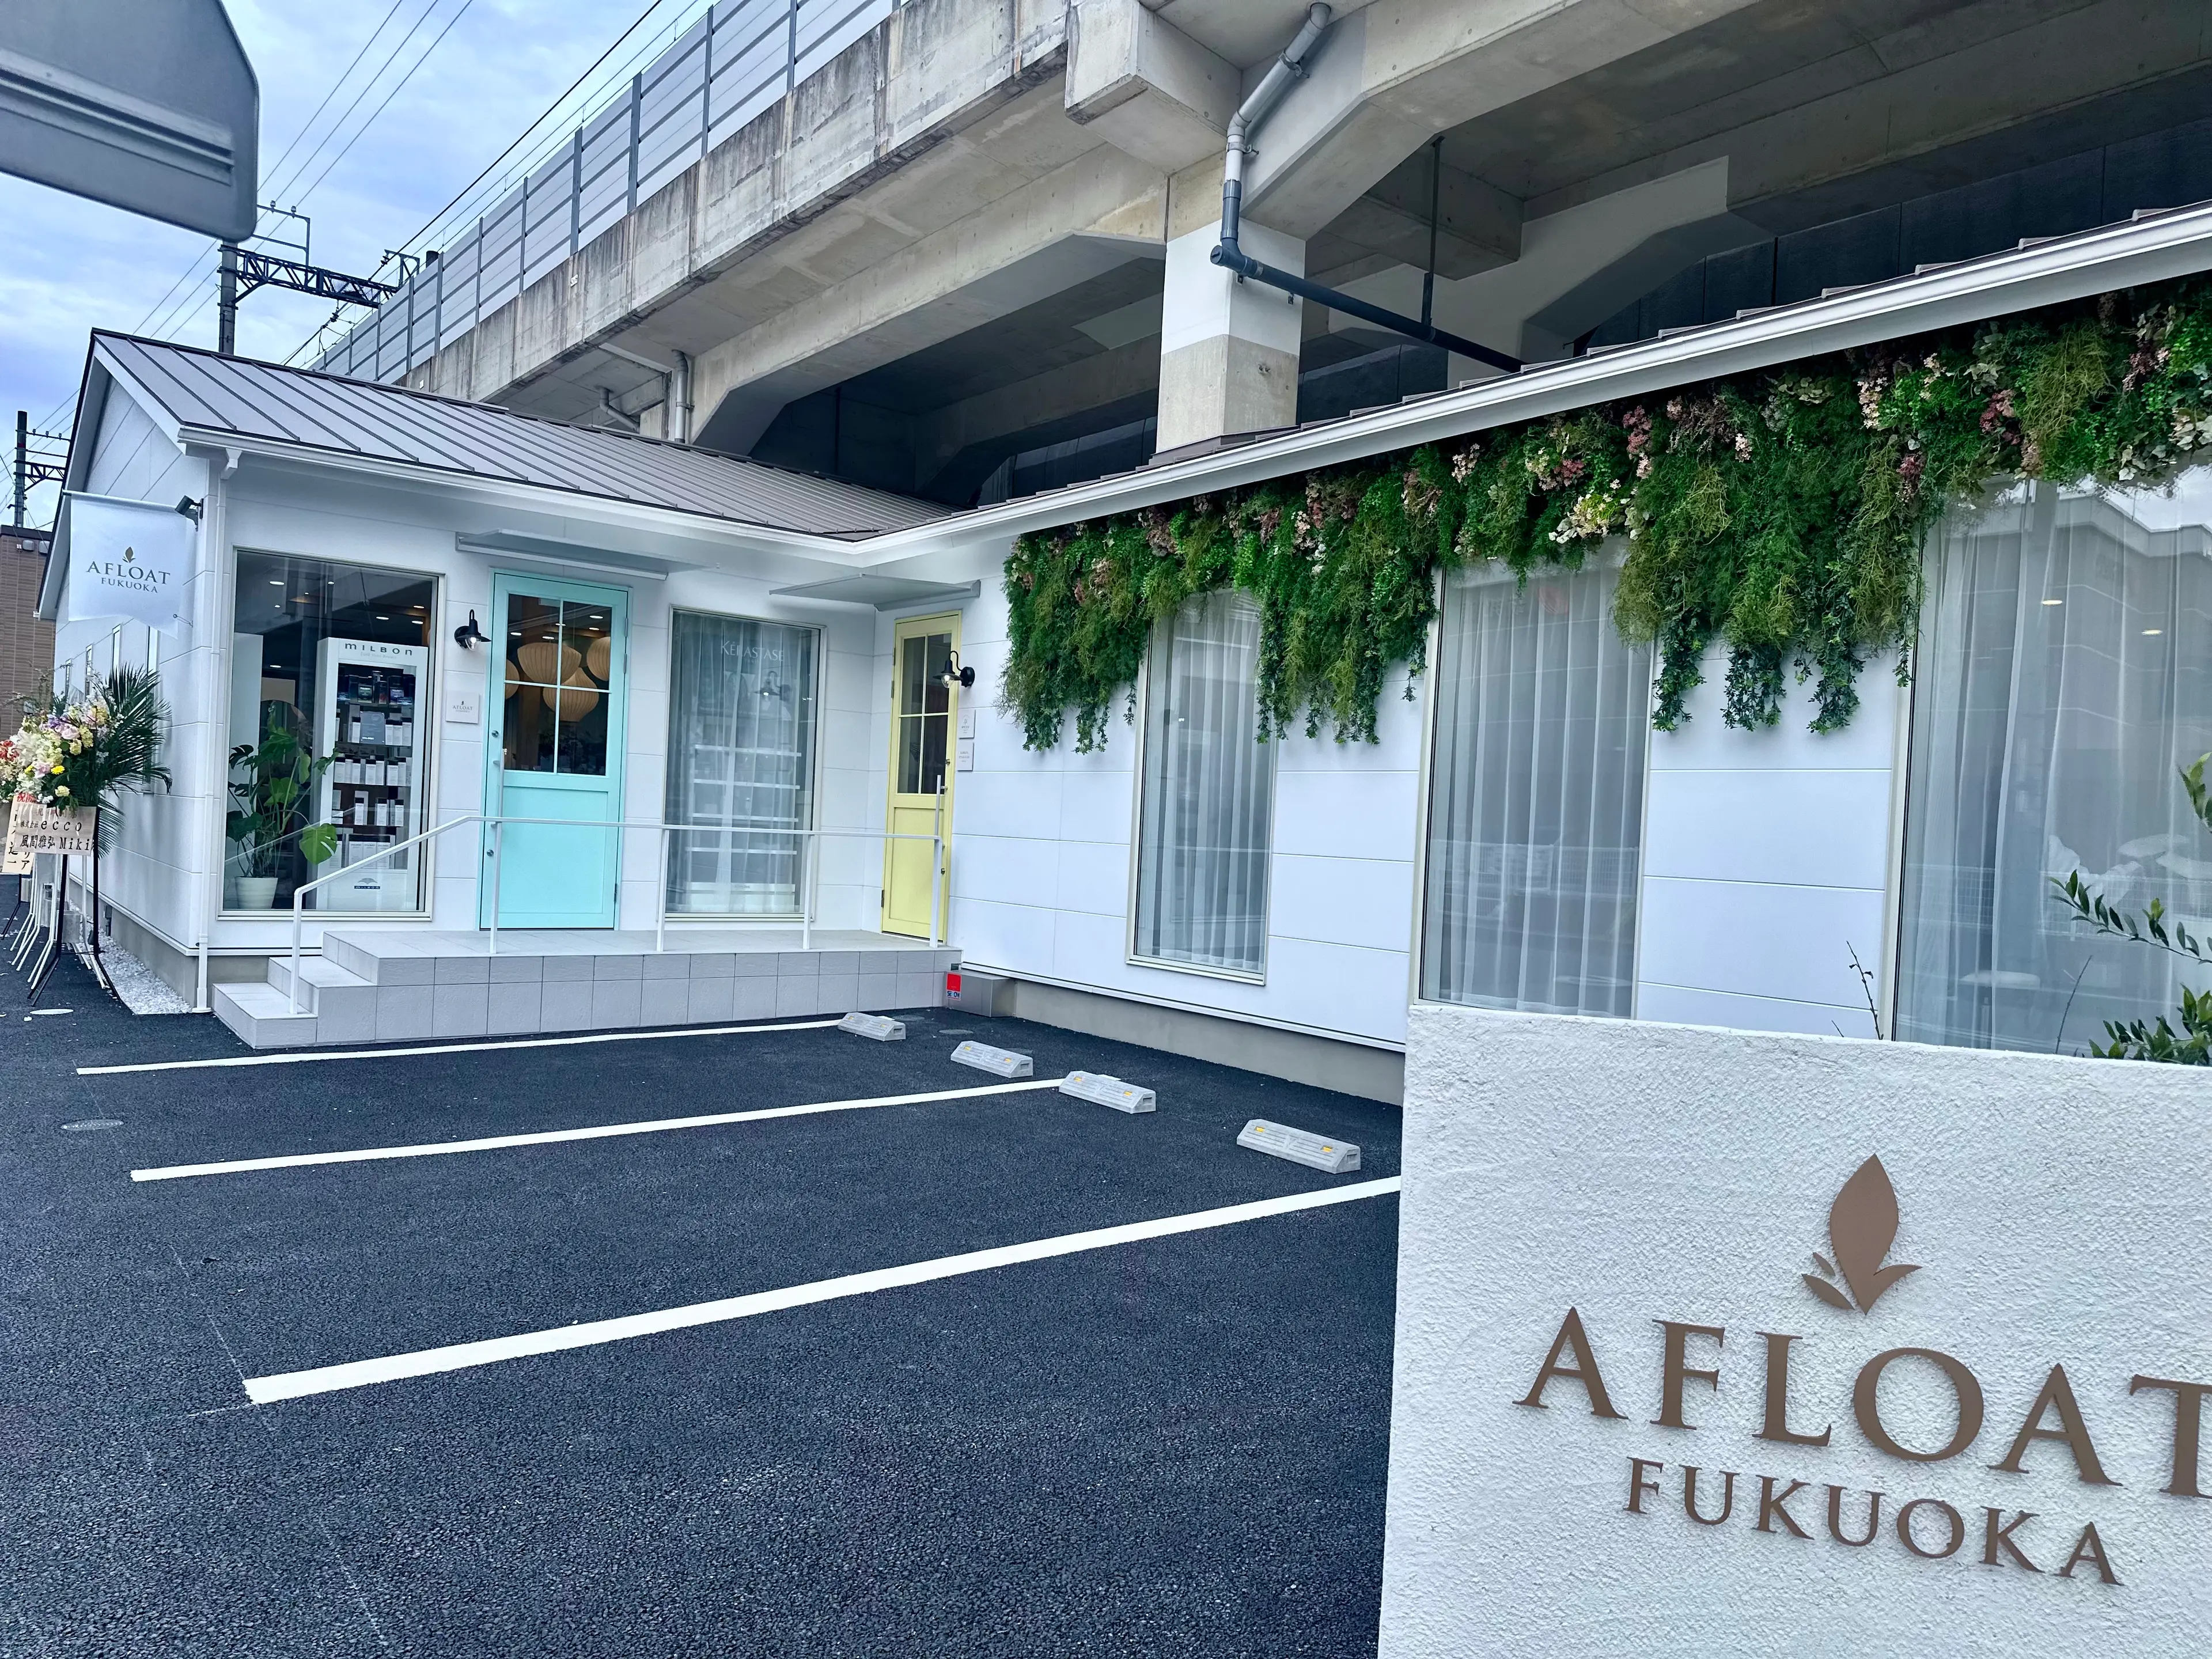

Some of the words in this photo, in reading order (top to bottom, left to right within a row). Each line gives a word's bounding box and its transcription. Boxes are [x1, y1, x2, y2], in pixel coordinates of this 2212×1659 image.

[86, 560, 171, 585] AFLOAT
[101, 577, 158, 593] FUKUOKA
[41, 820, 82, 831] ecco
[59, 837, 90, 850] Miki
[1512, 1306, 2212, 1499] AFLOAT
[1623, 1456, 2124, 1586] FUKUOKA
